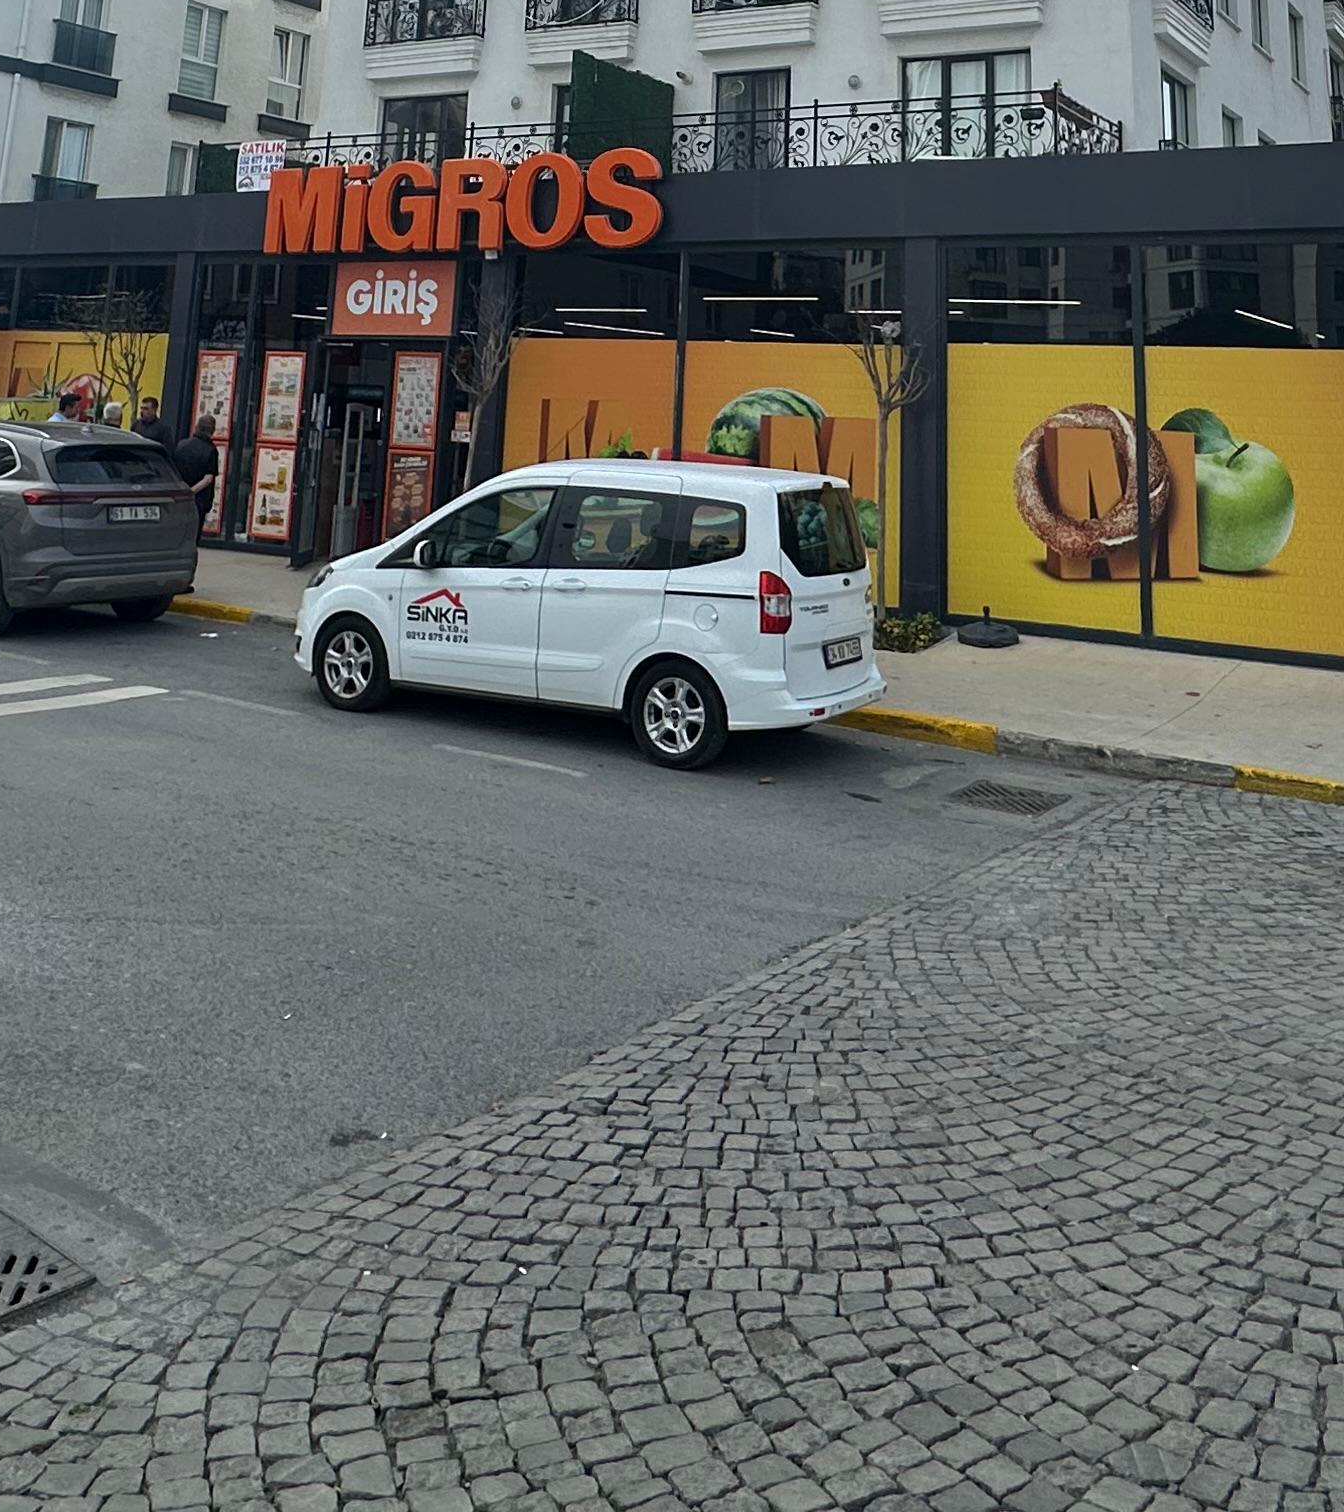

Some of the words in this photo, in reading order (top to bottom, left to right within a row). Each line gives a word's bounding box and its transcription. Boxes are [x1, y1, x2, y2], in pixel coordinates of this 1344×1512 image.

[241, 142, 285, 155] SATILIK
[347, 269, 439, 326] GİRİŞ
[406, 630, 426, 641] 0212
[445, 634, 451, 643] 4
